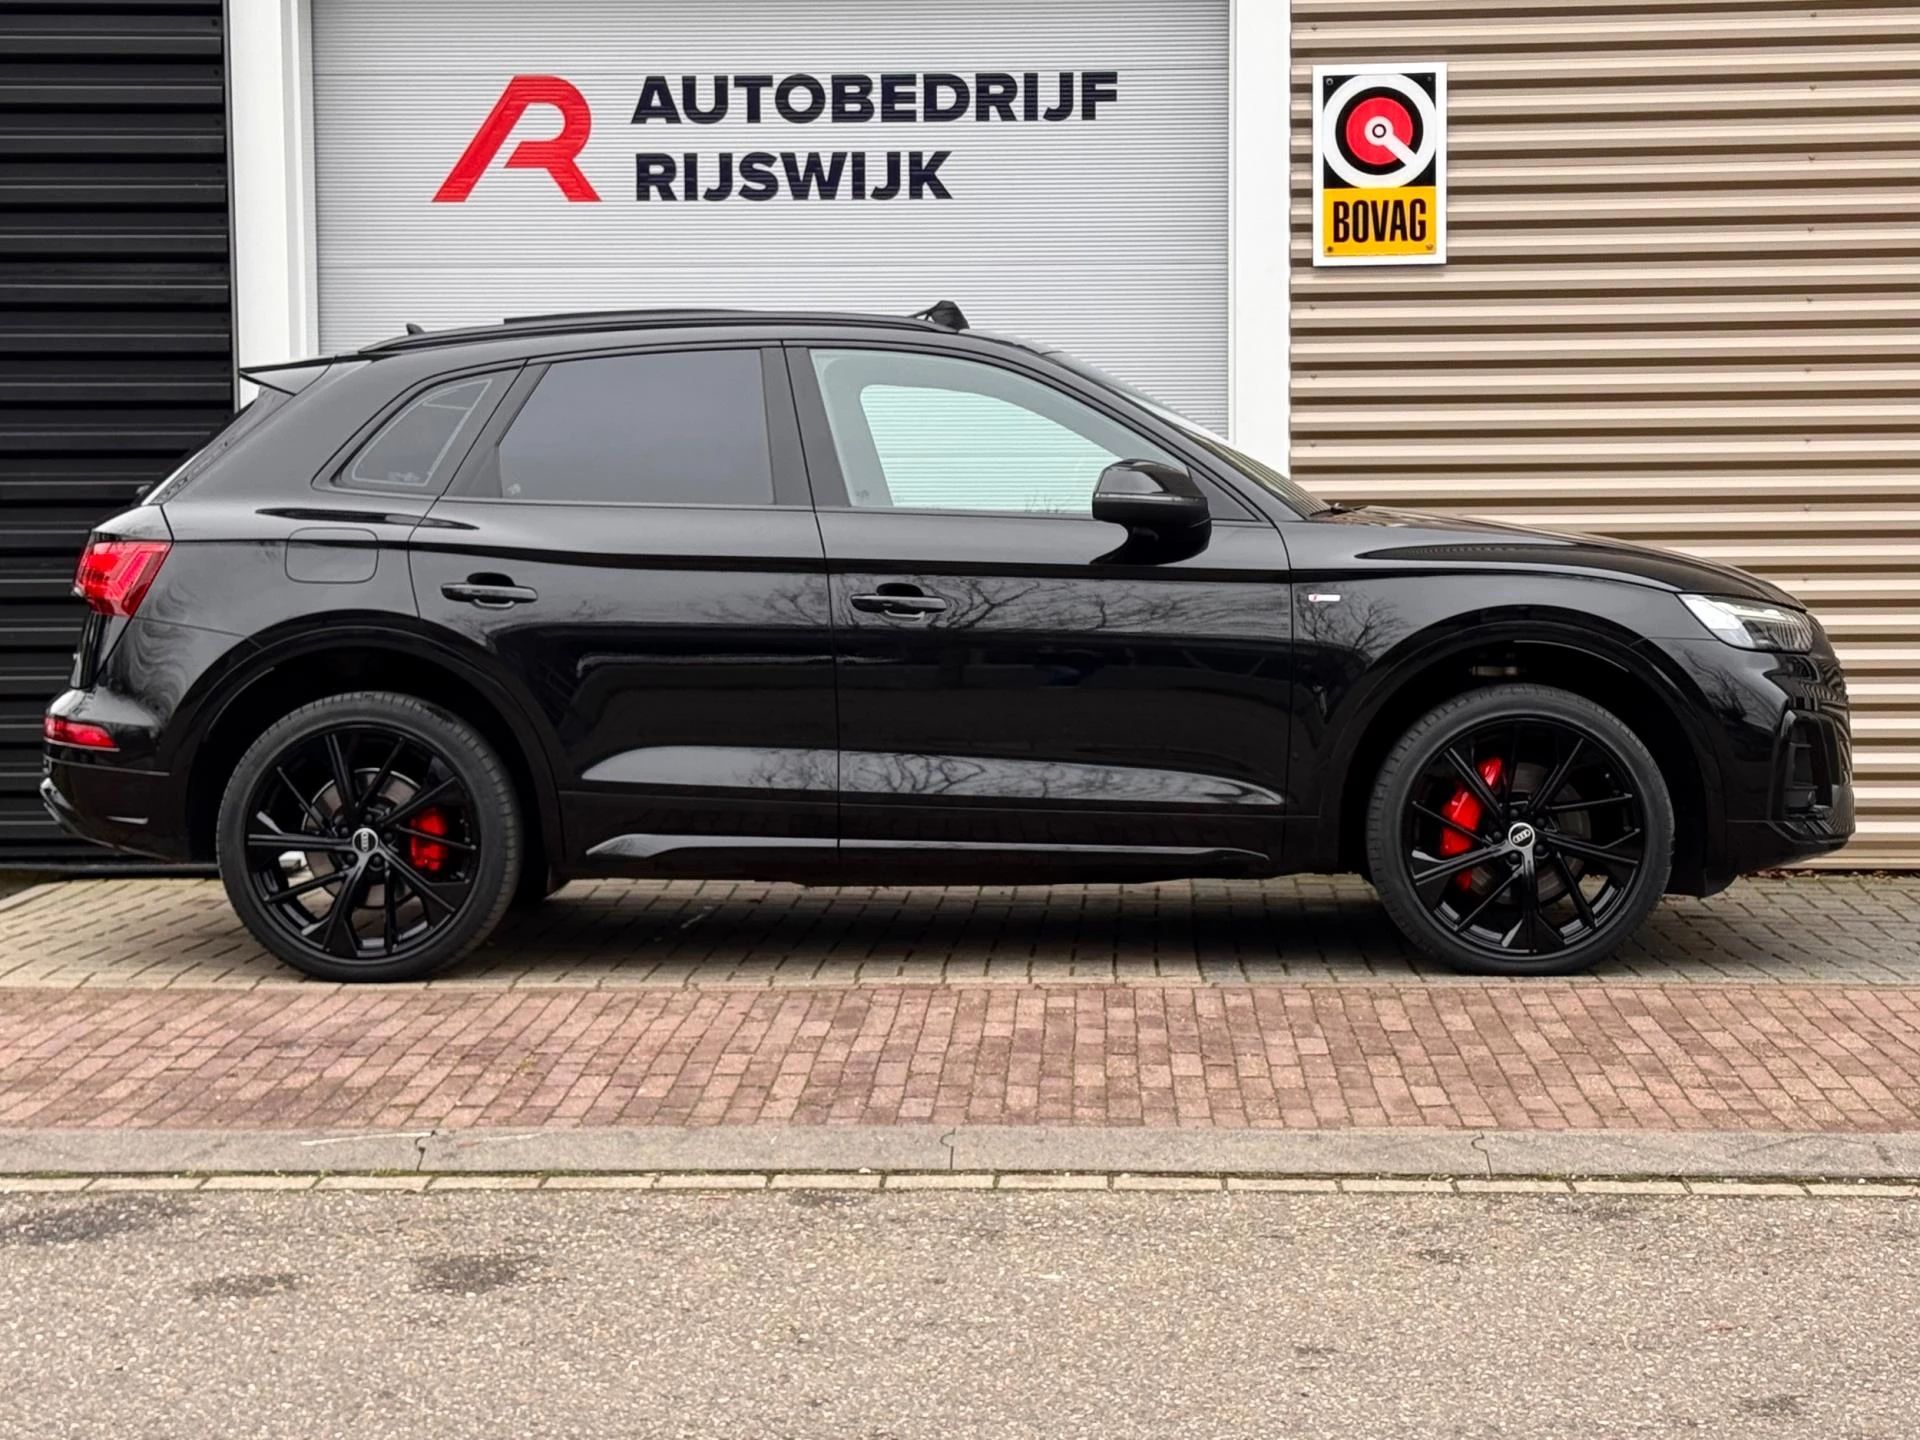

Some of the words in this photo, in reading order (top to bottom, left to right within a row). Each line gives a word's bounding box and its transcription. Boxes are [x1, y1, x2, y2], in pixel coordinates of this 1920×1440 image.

[631, 72, 1118, 124] AUTOBEDRIJF
[636, 151, 953, 201] RIJSWIJK
[1333, 198, 1427, 243] BOVAG
